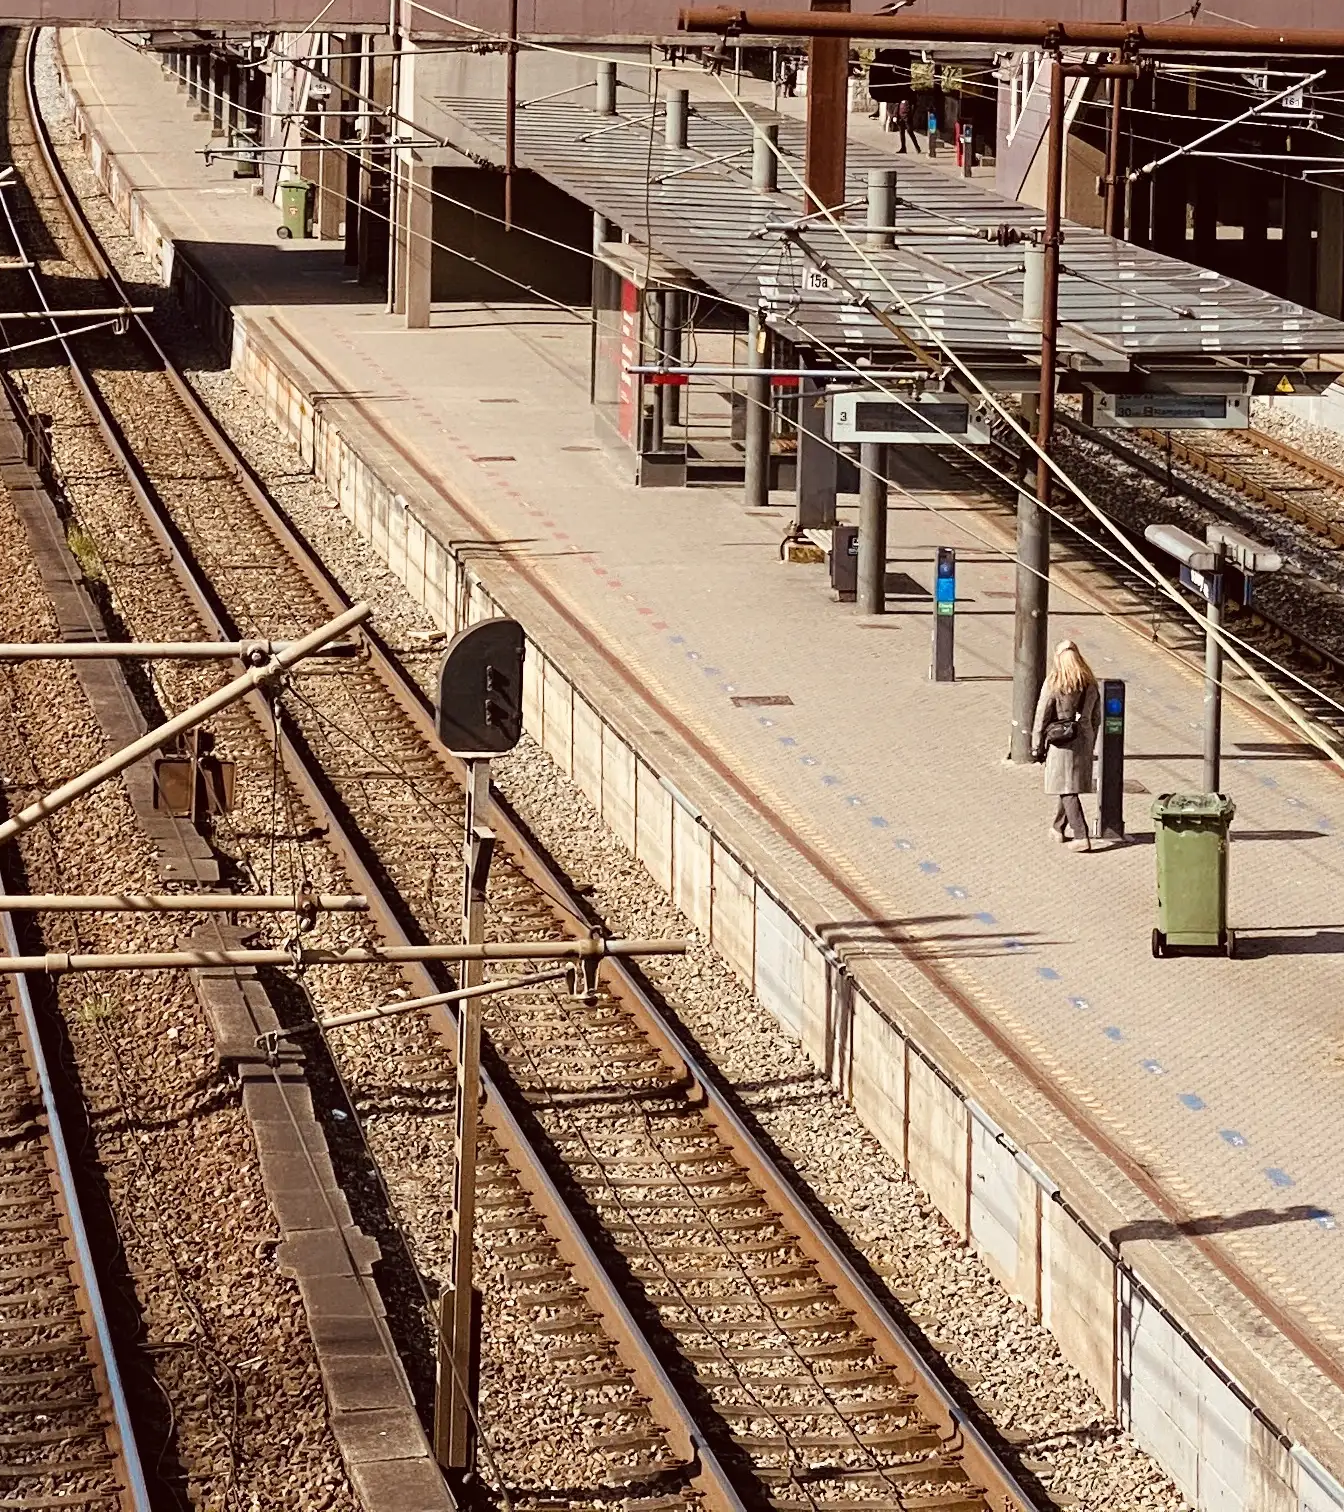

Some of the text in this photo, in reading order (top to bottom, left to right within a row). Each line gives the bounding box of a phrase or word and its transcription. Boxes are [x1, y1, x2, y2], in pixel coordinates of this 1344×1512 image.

[810, 273, 828, 288] 15a
[1099, 396, 1108, 406] 4
[840, 411, 848, 422] 3
